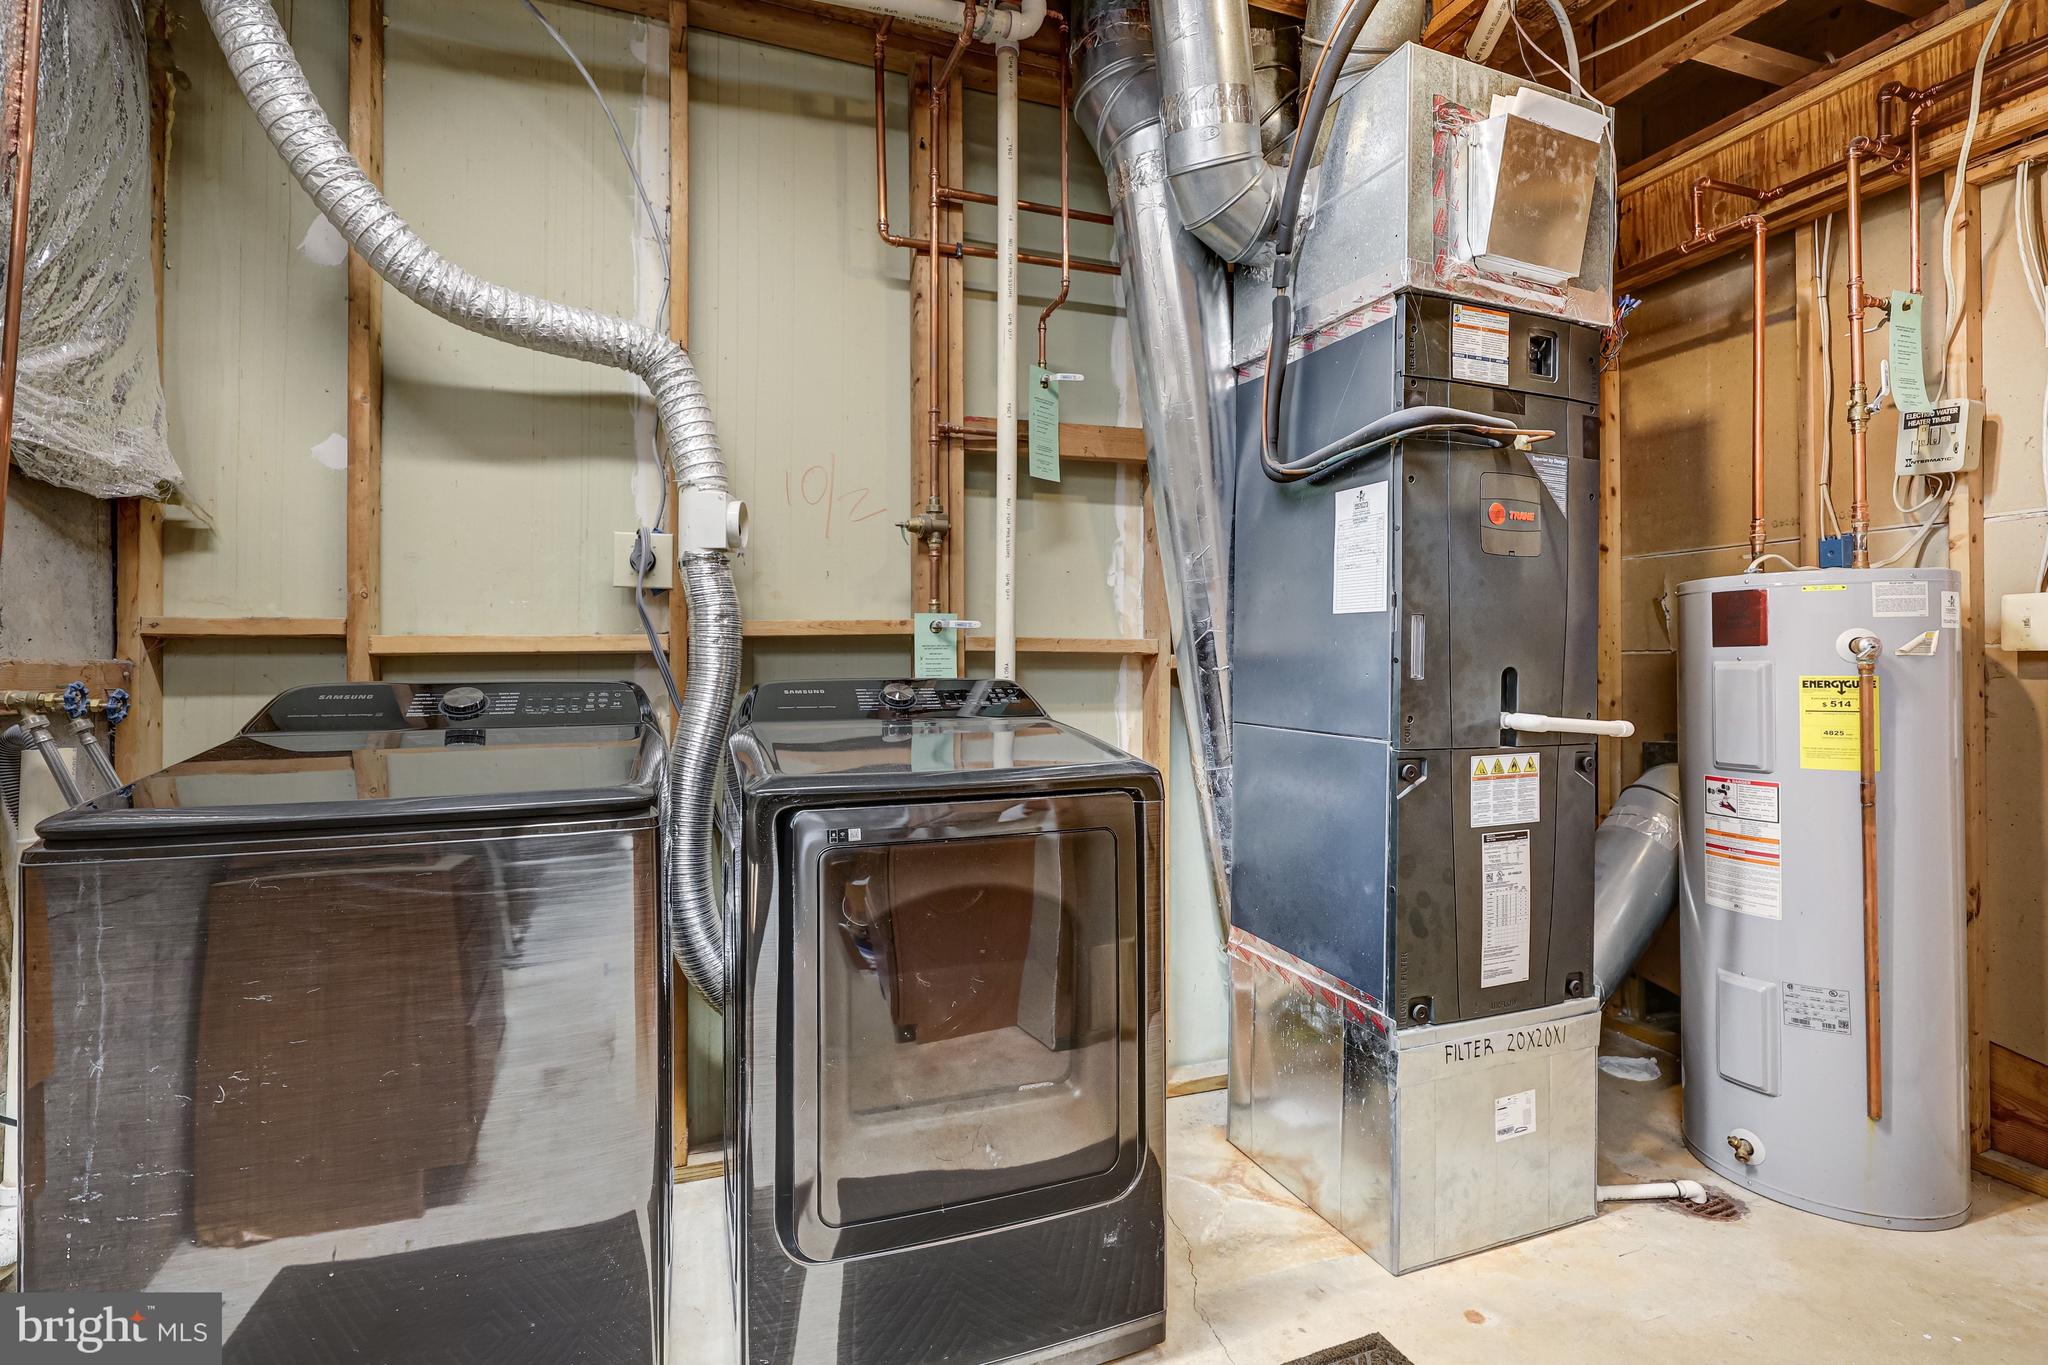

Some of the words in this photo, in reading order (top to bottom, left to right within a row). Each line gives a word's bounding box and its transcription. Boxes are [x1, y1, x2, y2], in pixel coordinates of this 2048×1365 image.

[1936, 407, 1959, 416] WATER
[1908, 418, 1930, 427] HEATER
[1932, 415, 1951, 424] TIMER
[785, 451, 888, 540] 10/2
[1509, 510, 1536, 522] TRANE
[1444, 1038, 1494, 1064] FILTER
